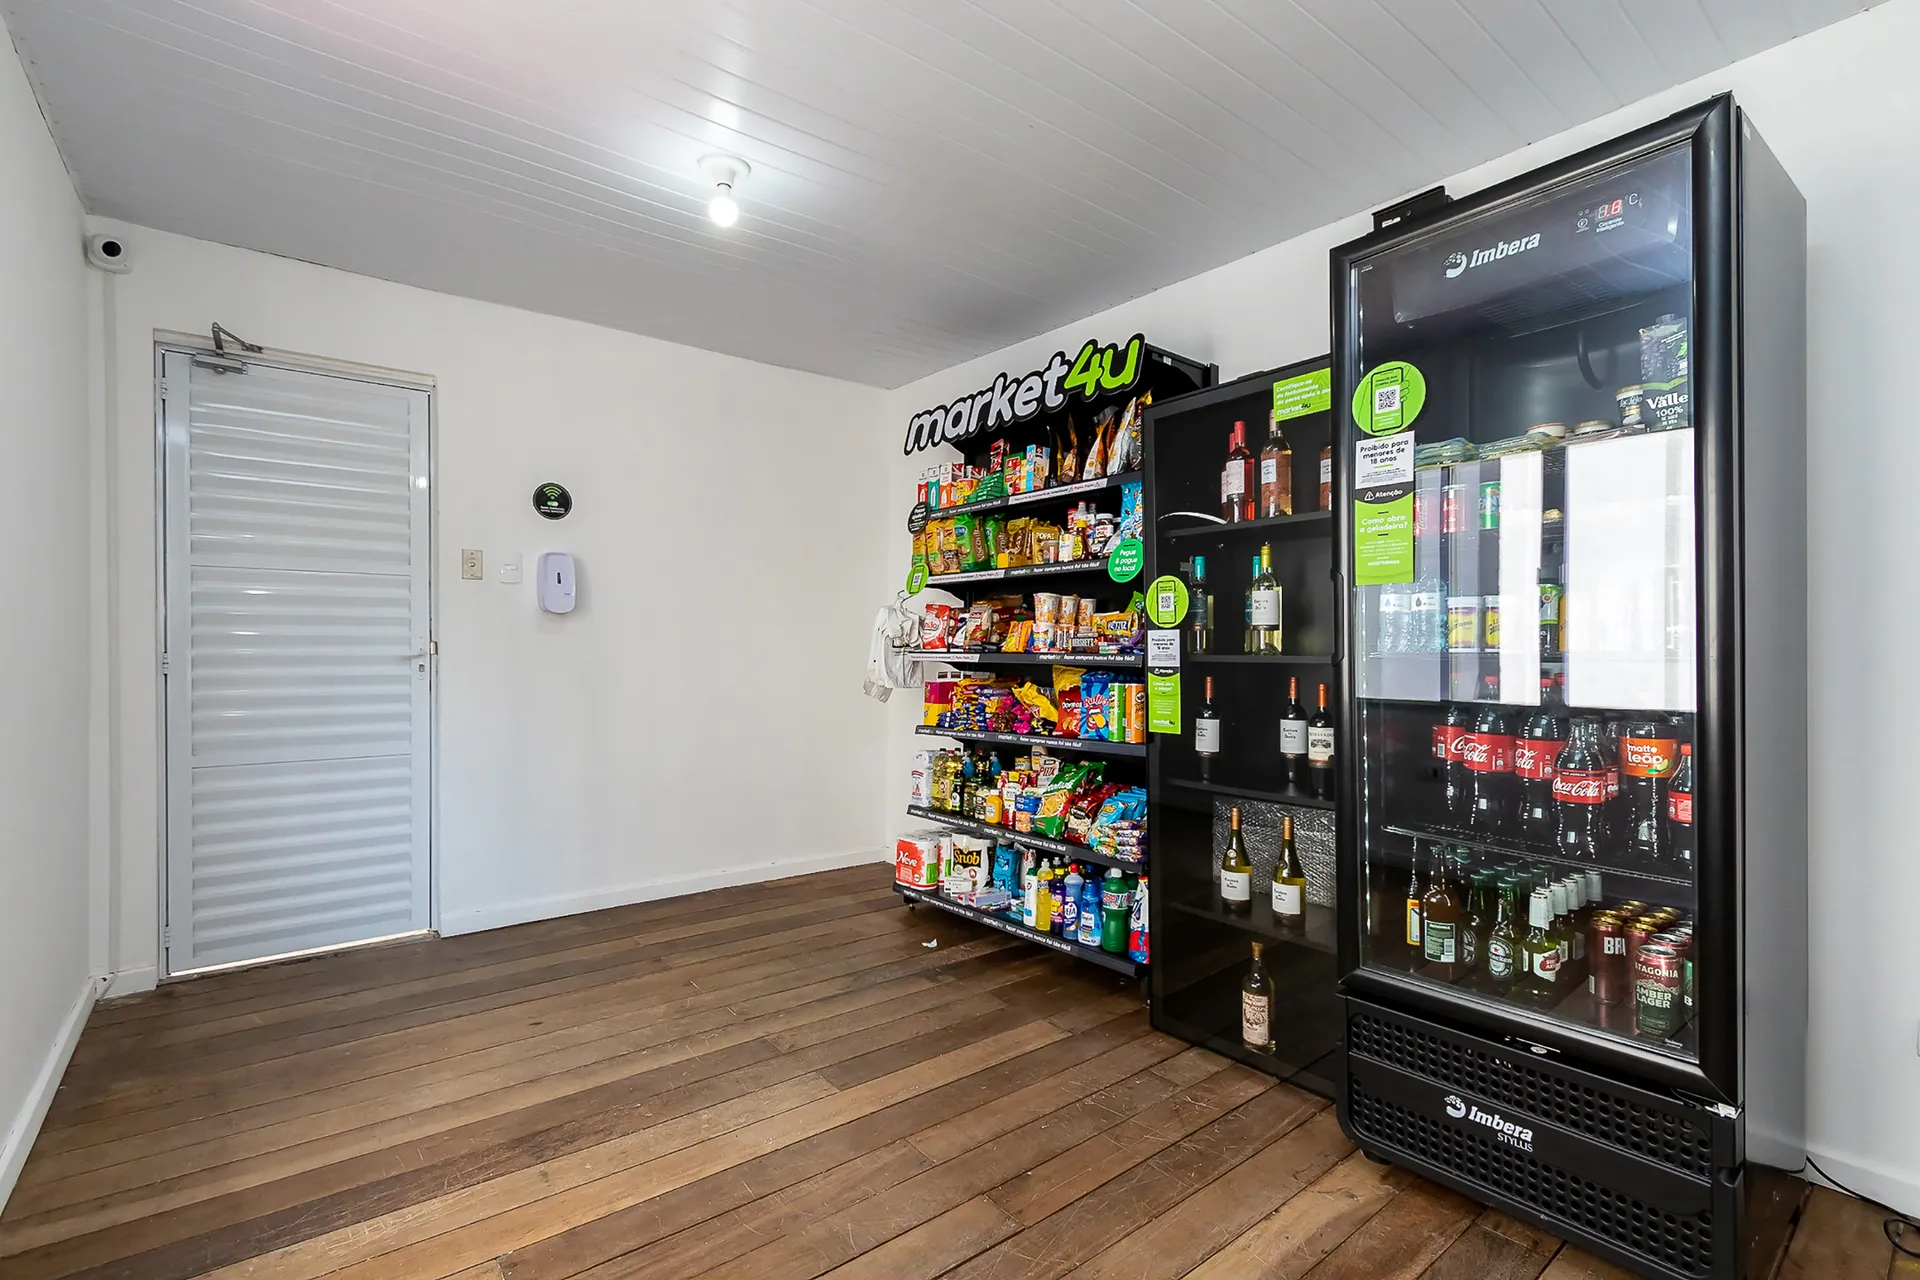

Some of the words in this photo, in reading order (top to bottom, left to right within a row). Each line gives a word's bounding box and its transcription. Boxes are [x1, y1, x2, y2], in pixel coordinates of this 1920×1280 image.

[1469, 233, 1540, 268] Imbera
[1646, 393, 1688, 409] Valle
[1656, 405, 1683, 417] 100%
[1360, 443, 1389, 453] Proibido
[1391, 440, 1409, 448] para
[1363, 449, 1394, 459] menores
[1375, 489, 1402, 498] Atenção
[1367, 521, 1408, 534] geladeira?
[1062, 701, 1082, 709] Doritos
[1084, 694, 1109, 708] Ruffles
[1553, 777, 1601, 797] Coca-Cola
[897, 850, 918, 867] Neve
[954, 849, 980, 866] Snob
[1636, 985, 1672, 1000] AMBER
[1636, 993, 1671, 1008] LAGER
[1468, 1105, 1533, 1141] Imbera
[1498, 1132, 1534, 1153] STYLUS
